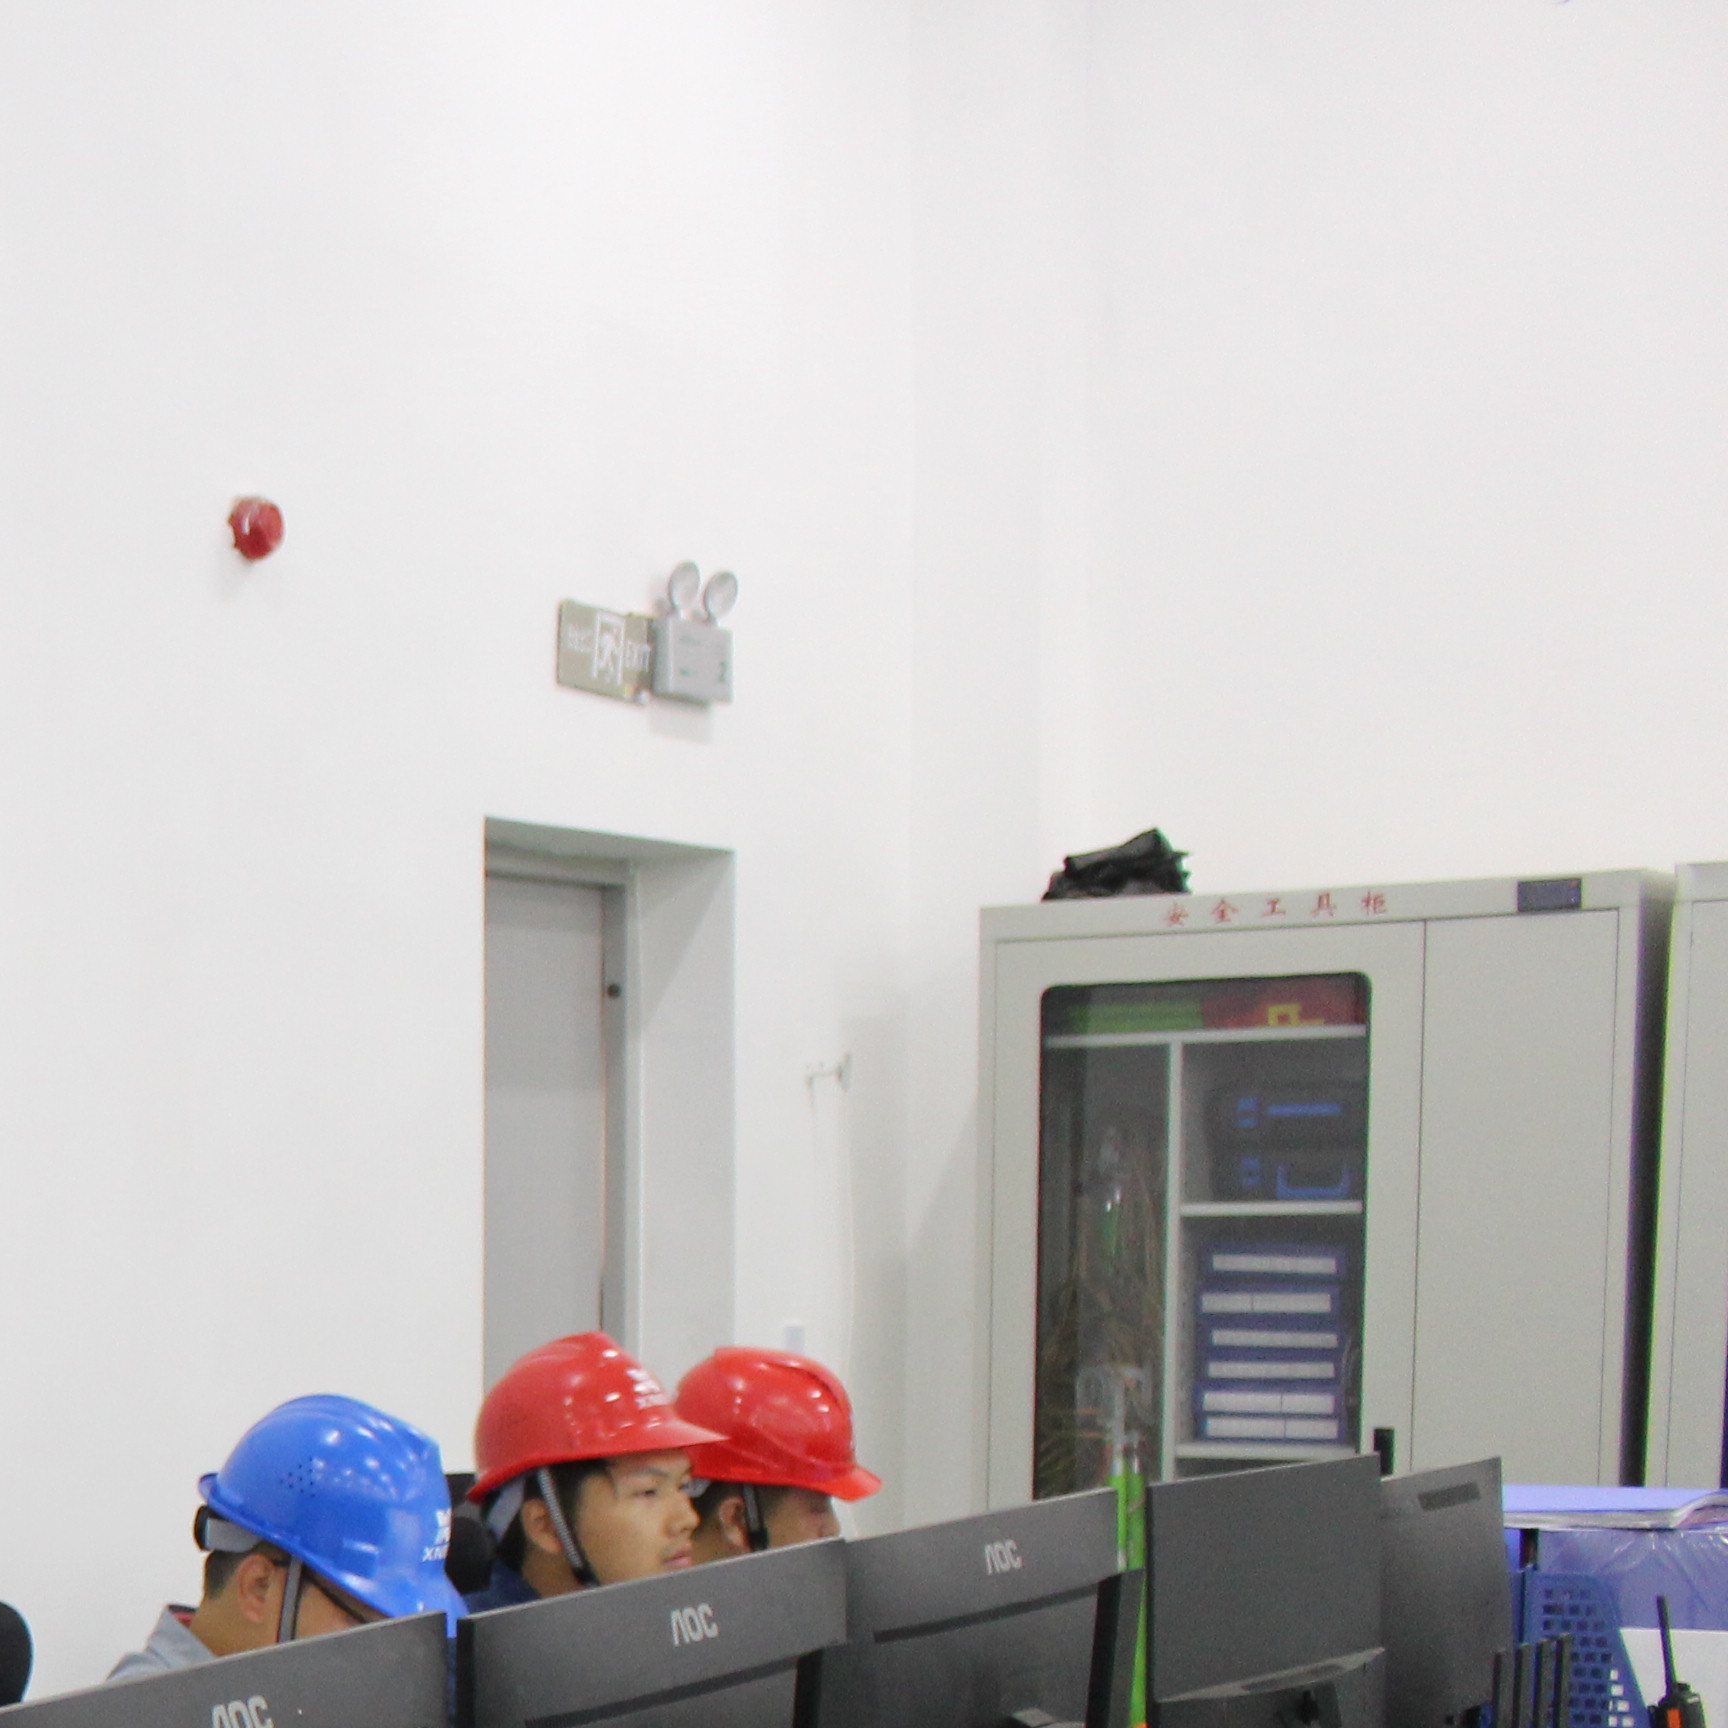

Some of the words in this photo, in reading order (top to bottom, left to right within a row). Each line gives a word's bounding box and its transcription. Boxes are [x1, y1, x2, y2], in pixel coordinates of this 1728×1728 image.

[1163, 890, 1388, 927] 安全工具柜
[984, 1539, 1023, 1575] AOC
[671, 1603, 718, 1647] AOC
